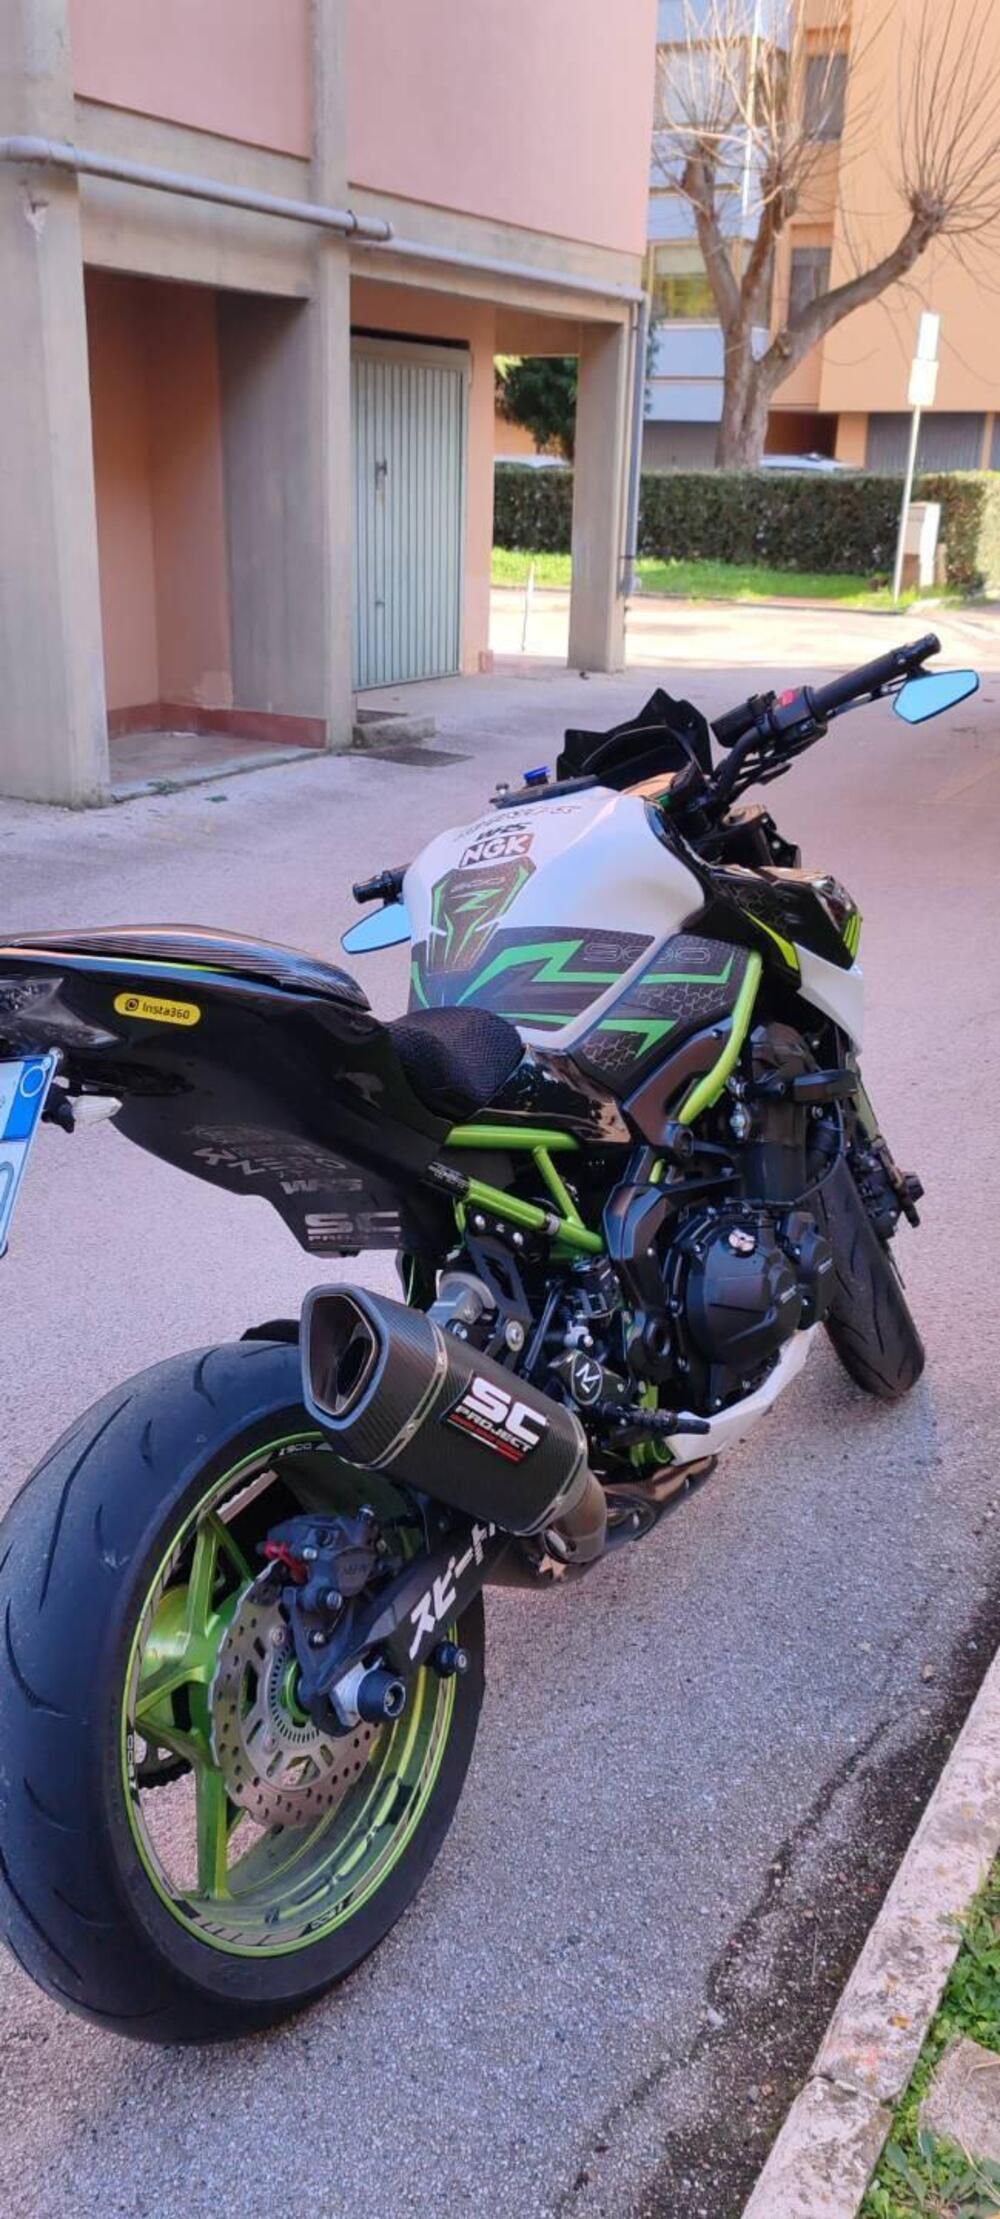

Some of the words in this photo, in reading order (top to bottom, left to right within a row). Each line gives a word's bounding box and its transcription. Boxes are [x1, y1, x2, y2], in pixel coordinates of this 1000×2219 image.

[460, 834, 534, 868] NGK
[142, 1002, 191, 1020] Insta360
[304, 1210, 402, 1235] SC
[461, 1376, 551, 1446] SC
[455, 1404, 534, 1453] PROJECT
